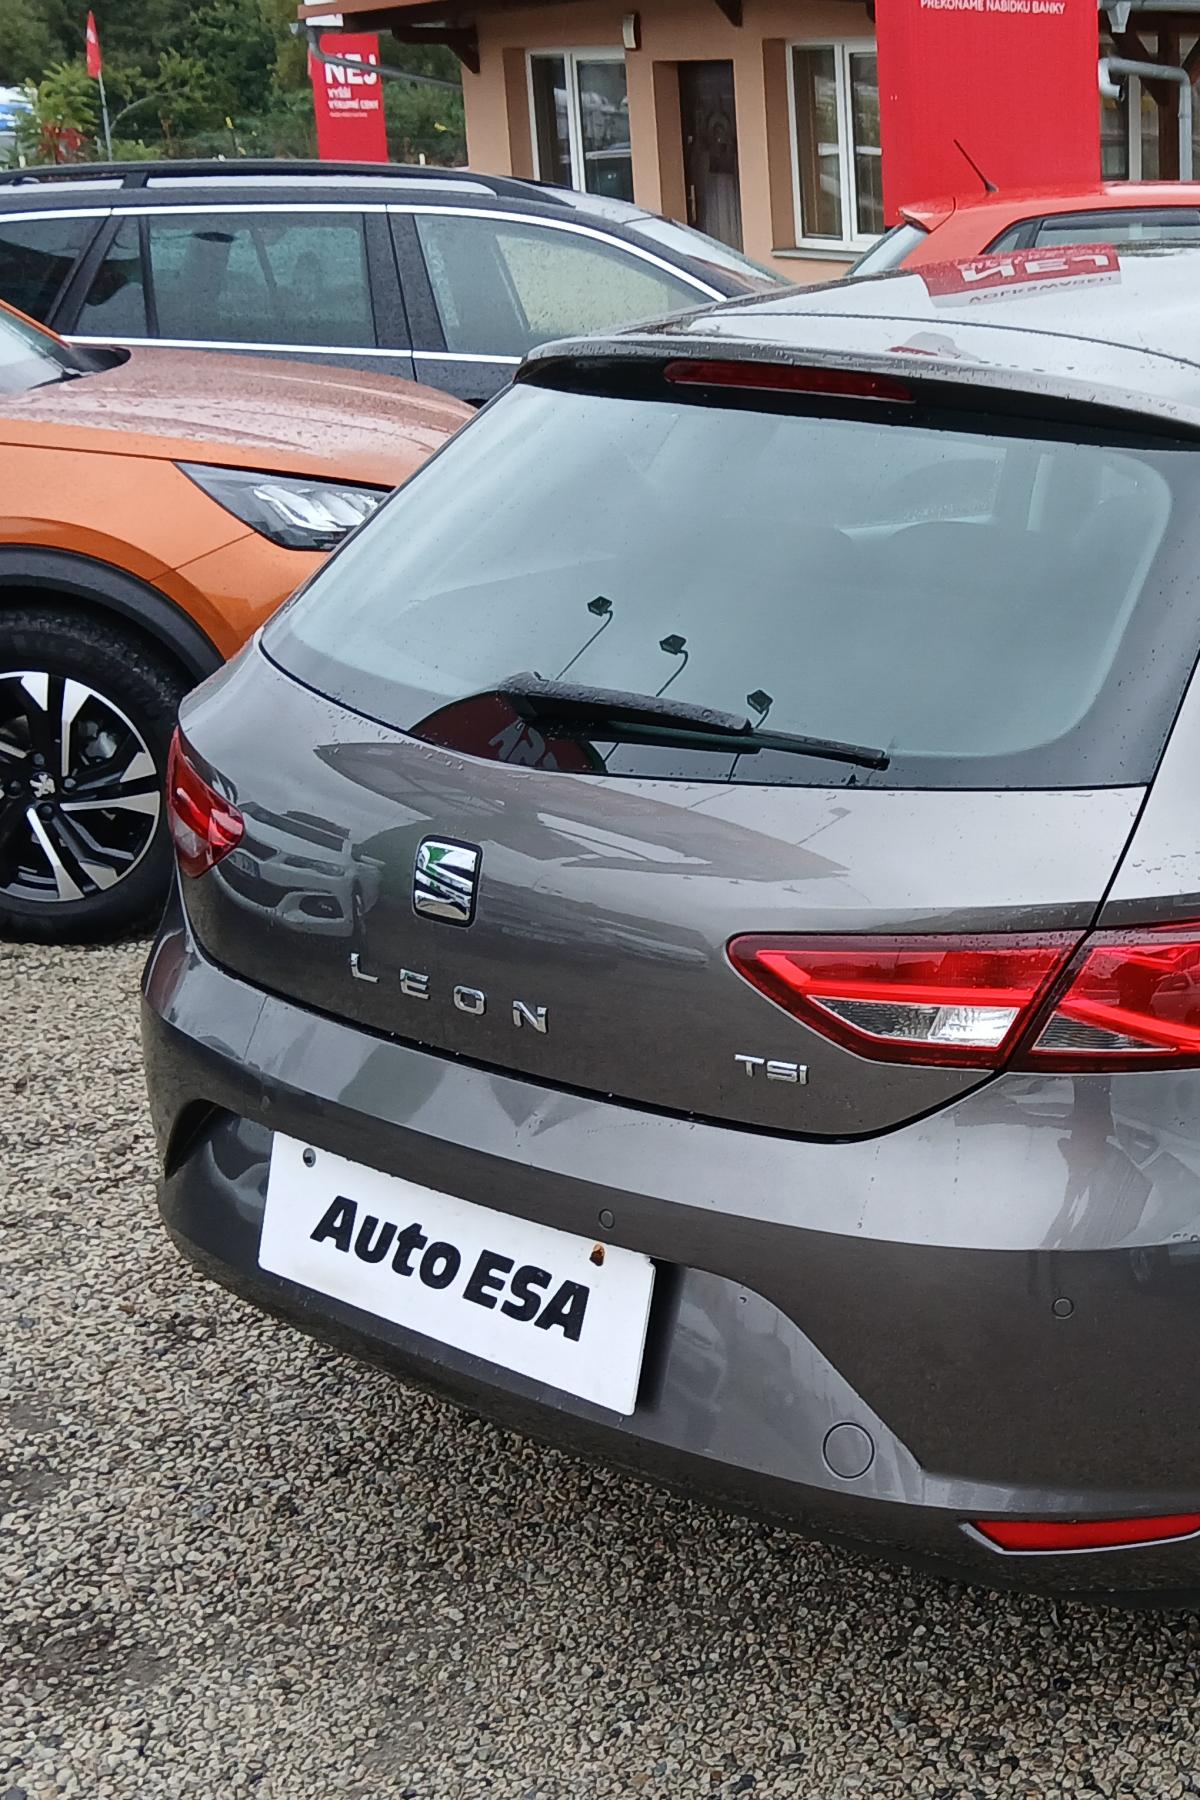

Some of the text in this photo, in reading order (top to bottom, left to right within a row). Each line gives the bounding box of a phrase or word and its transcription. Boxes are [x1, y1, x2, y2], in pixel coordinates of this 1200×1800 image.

[1032, 1, 1065, 14] BANKY
[324, 53, 378, 85] NEJ
[349, 953, 549, 1034] LEON
[310, 1195, 590, 1342] Auto ESA
